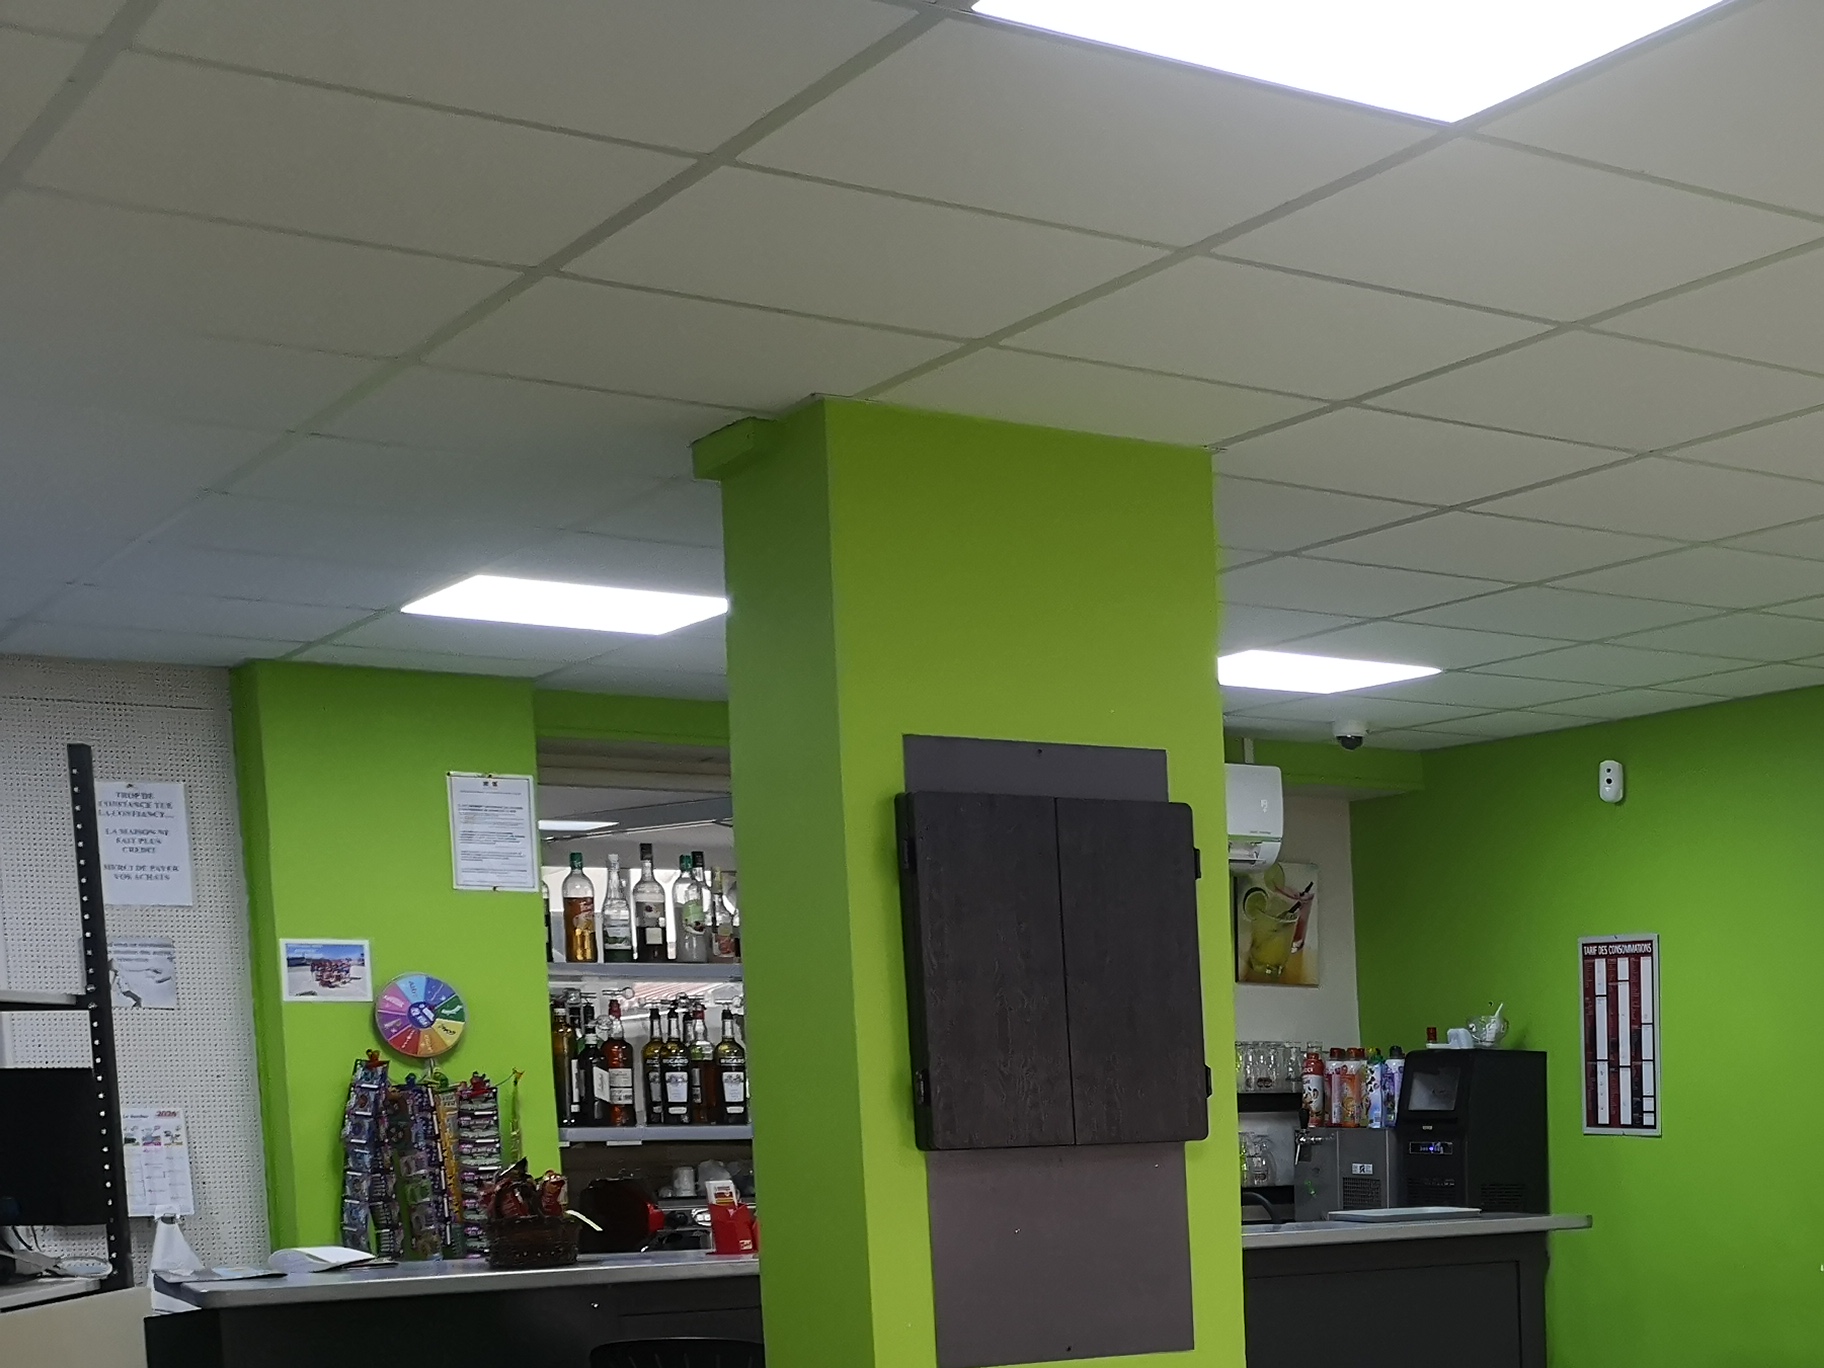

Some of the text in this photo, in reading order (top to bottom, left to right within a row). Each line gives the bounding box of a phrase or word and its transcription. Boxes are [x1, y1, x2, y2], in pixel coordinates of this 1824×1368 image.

[1584, 943, 1652, 955] TARIF DES CONSOMMATIONS
